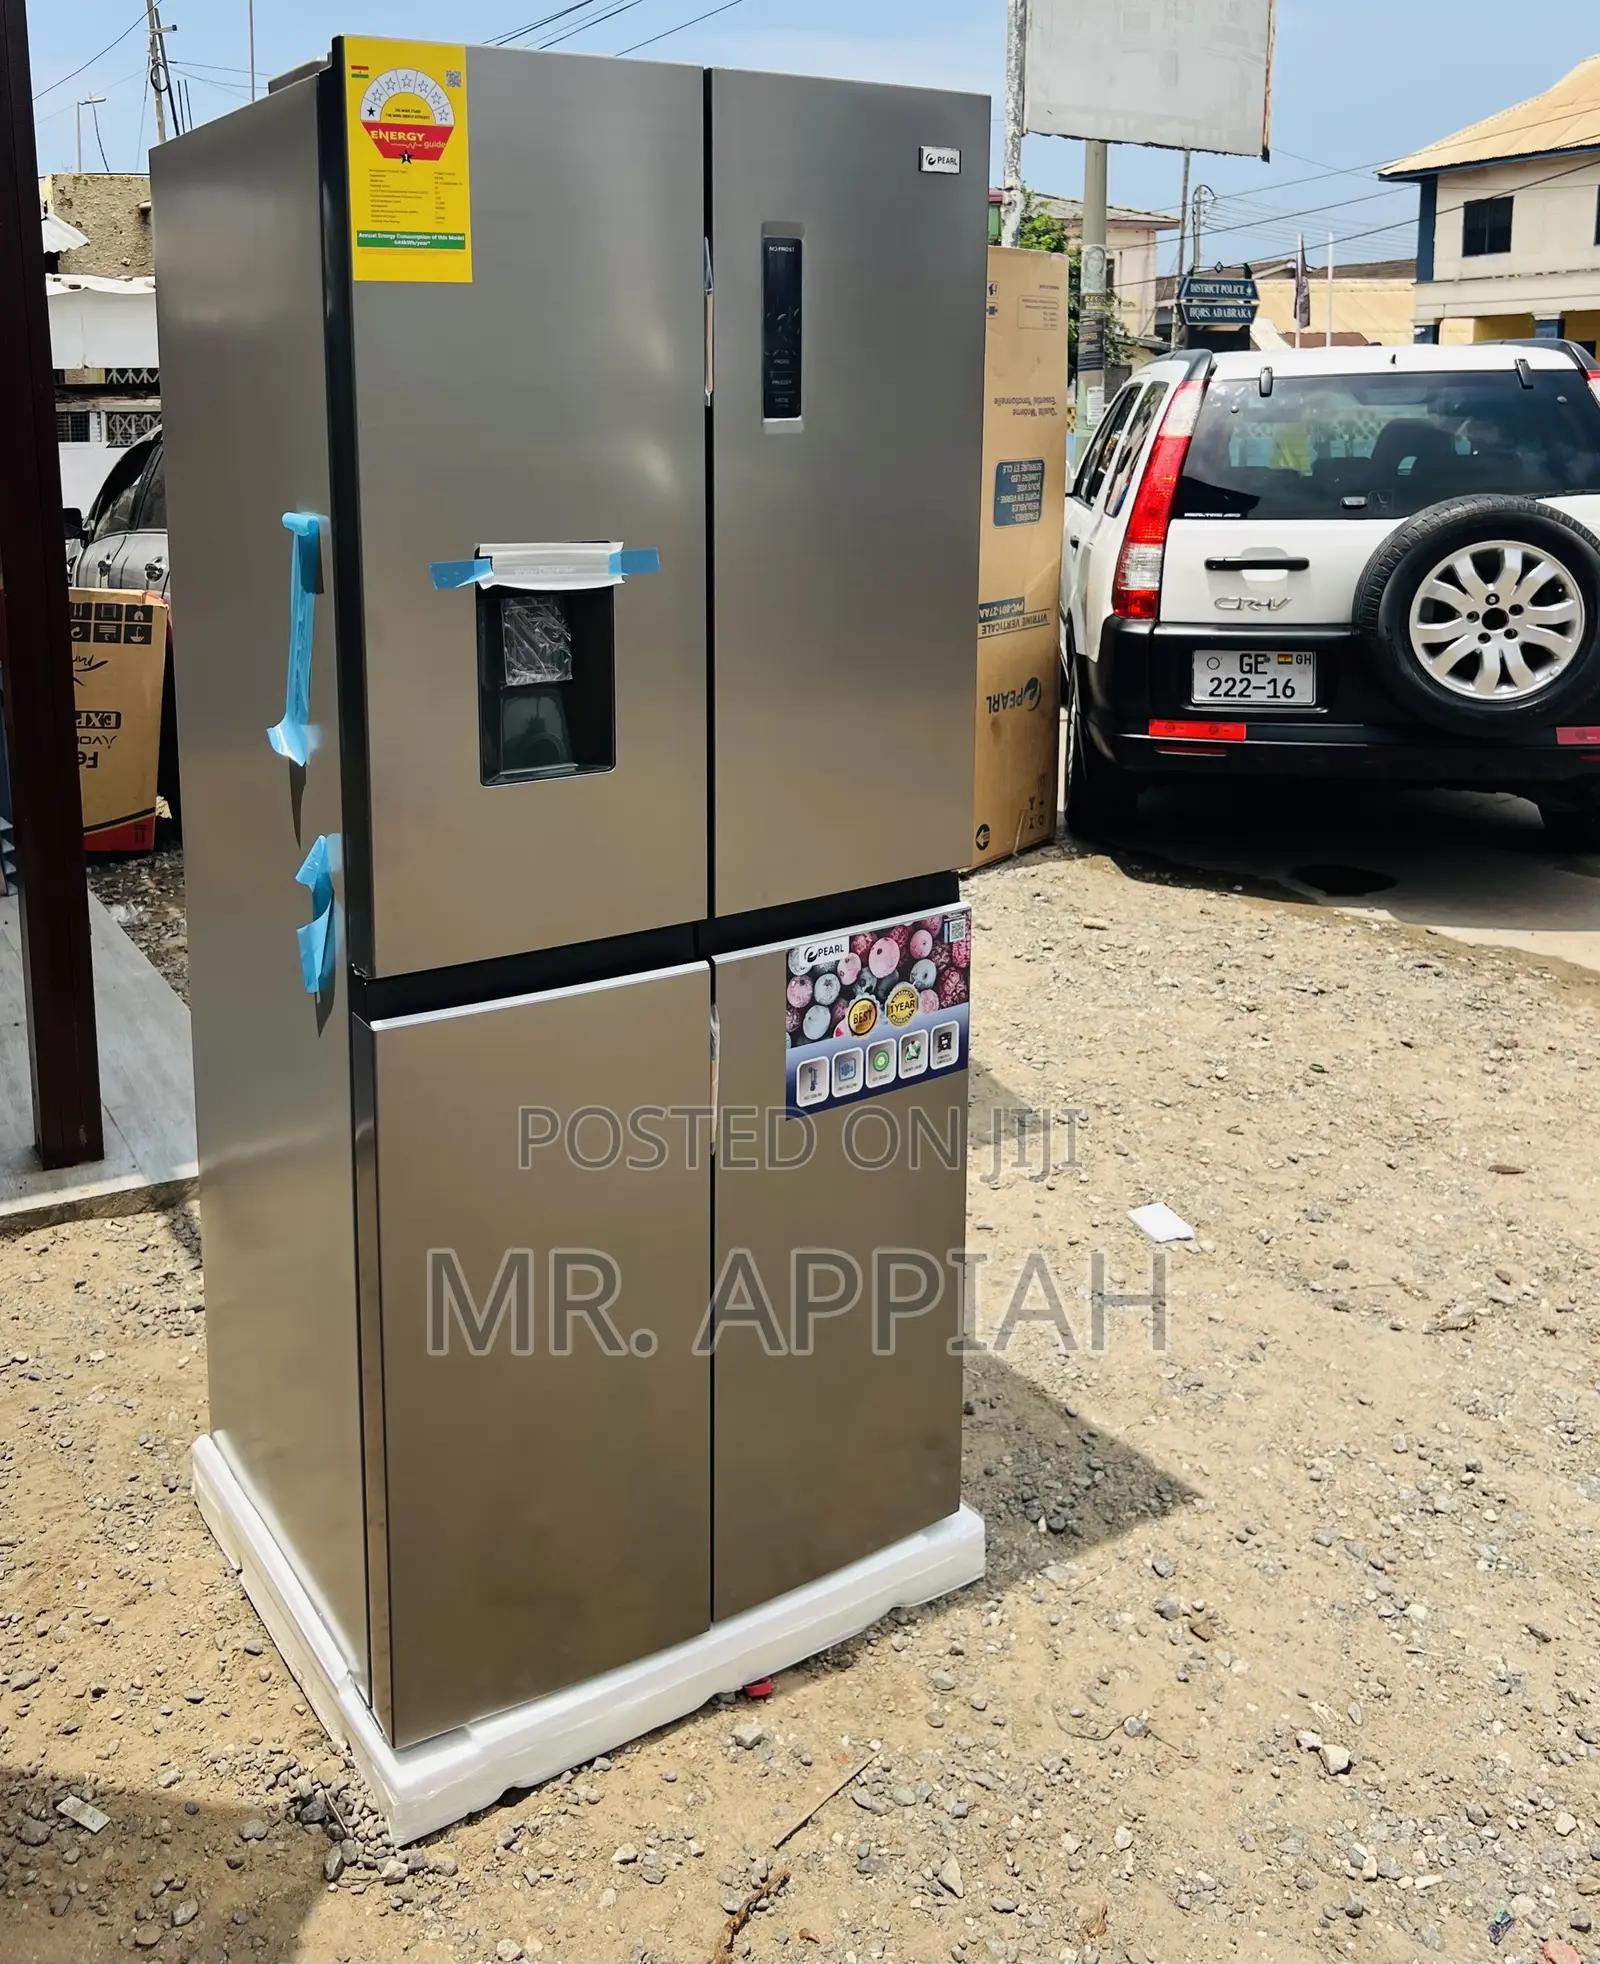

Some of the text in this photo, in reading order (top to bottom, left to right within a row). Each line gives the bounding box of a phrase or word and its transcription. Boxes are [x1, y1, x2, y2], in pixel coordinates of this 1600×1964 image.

[371, 129, 425, 142] ENERGY
[424, 141, 446, 149] guide
[937, 156, 958, 166] PEARL
[397, 233, 430, 241] Consumption
[1190, 283, 1245, 295] DISTRICT POLICE
[1214, 597, 1293, 611] CR-V
[981, 612, 1048, 635] VITRINE VERTICALE
[1240, 653, 1268, 675] GE
[1295, 654, 1312, 665] GH
[1209, 677, 1295, 699] 222-16
[985, 687, 1023, 714] PEARL
[78, 735, 117, 749] AVO
[817, 943, 844, 959] PEARL
[890, 999, 915, 1014] 1 YEAR
[853, 1009, 872, 1025] BEST
